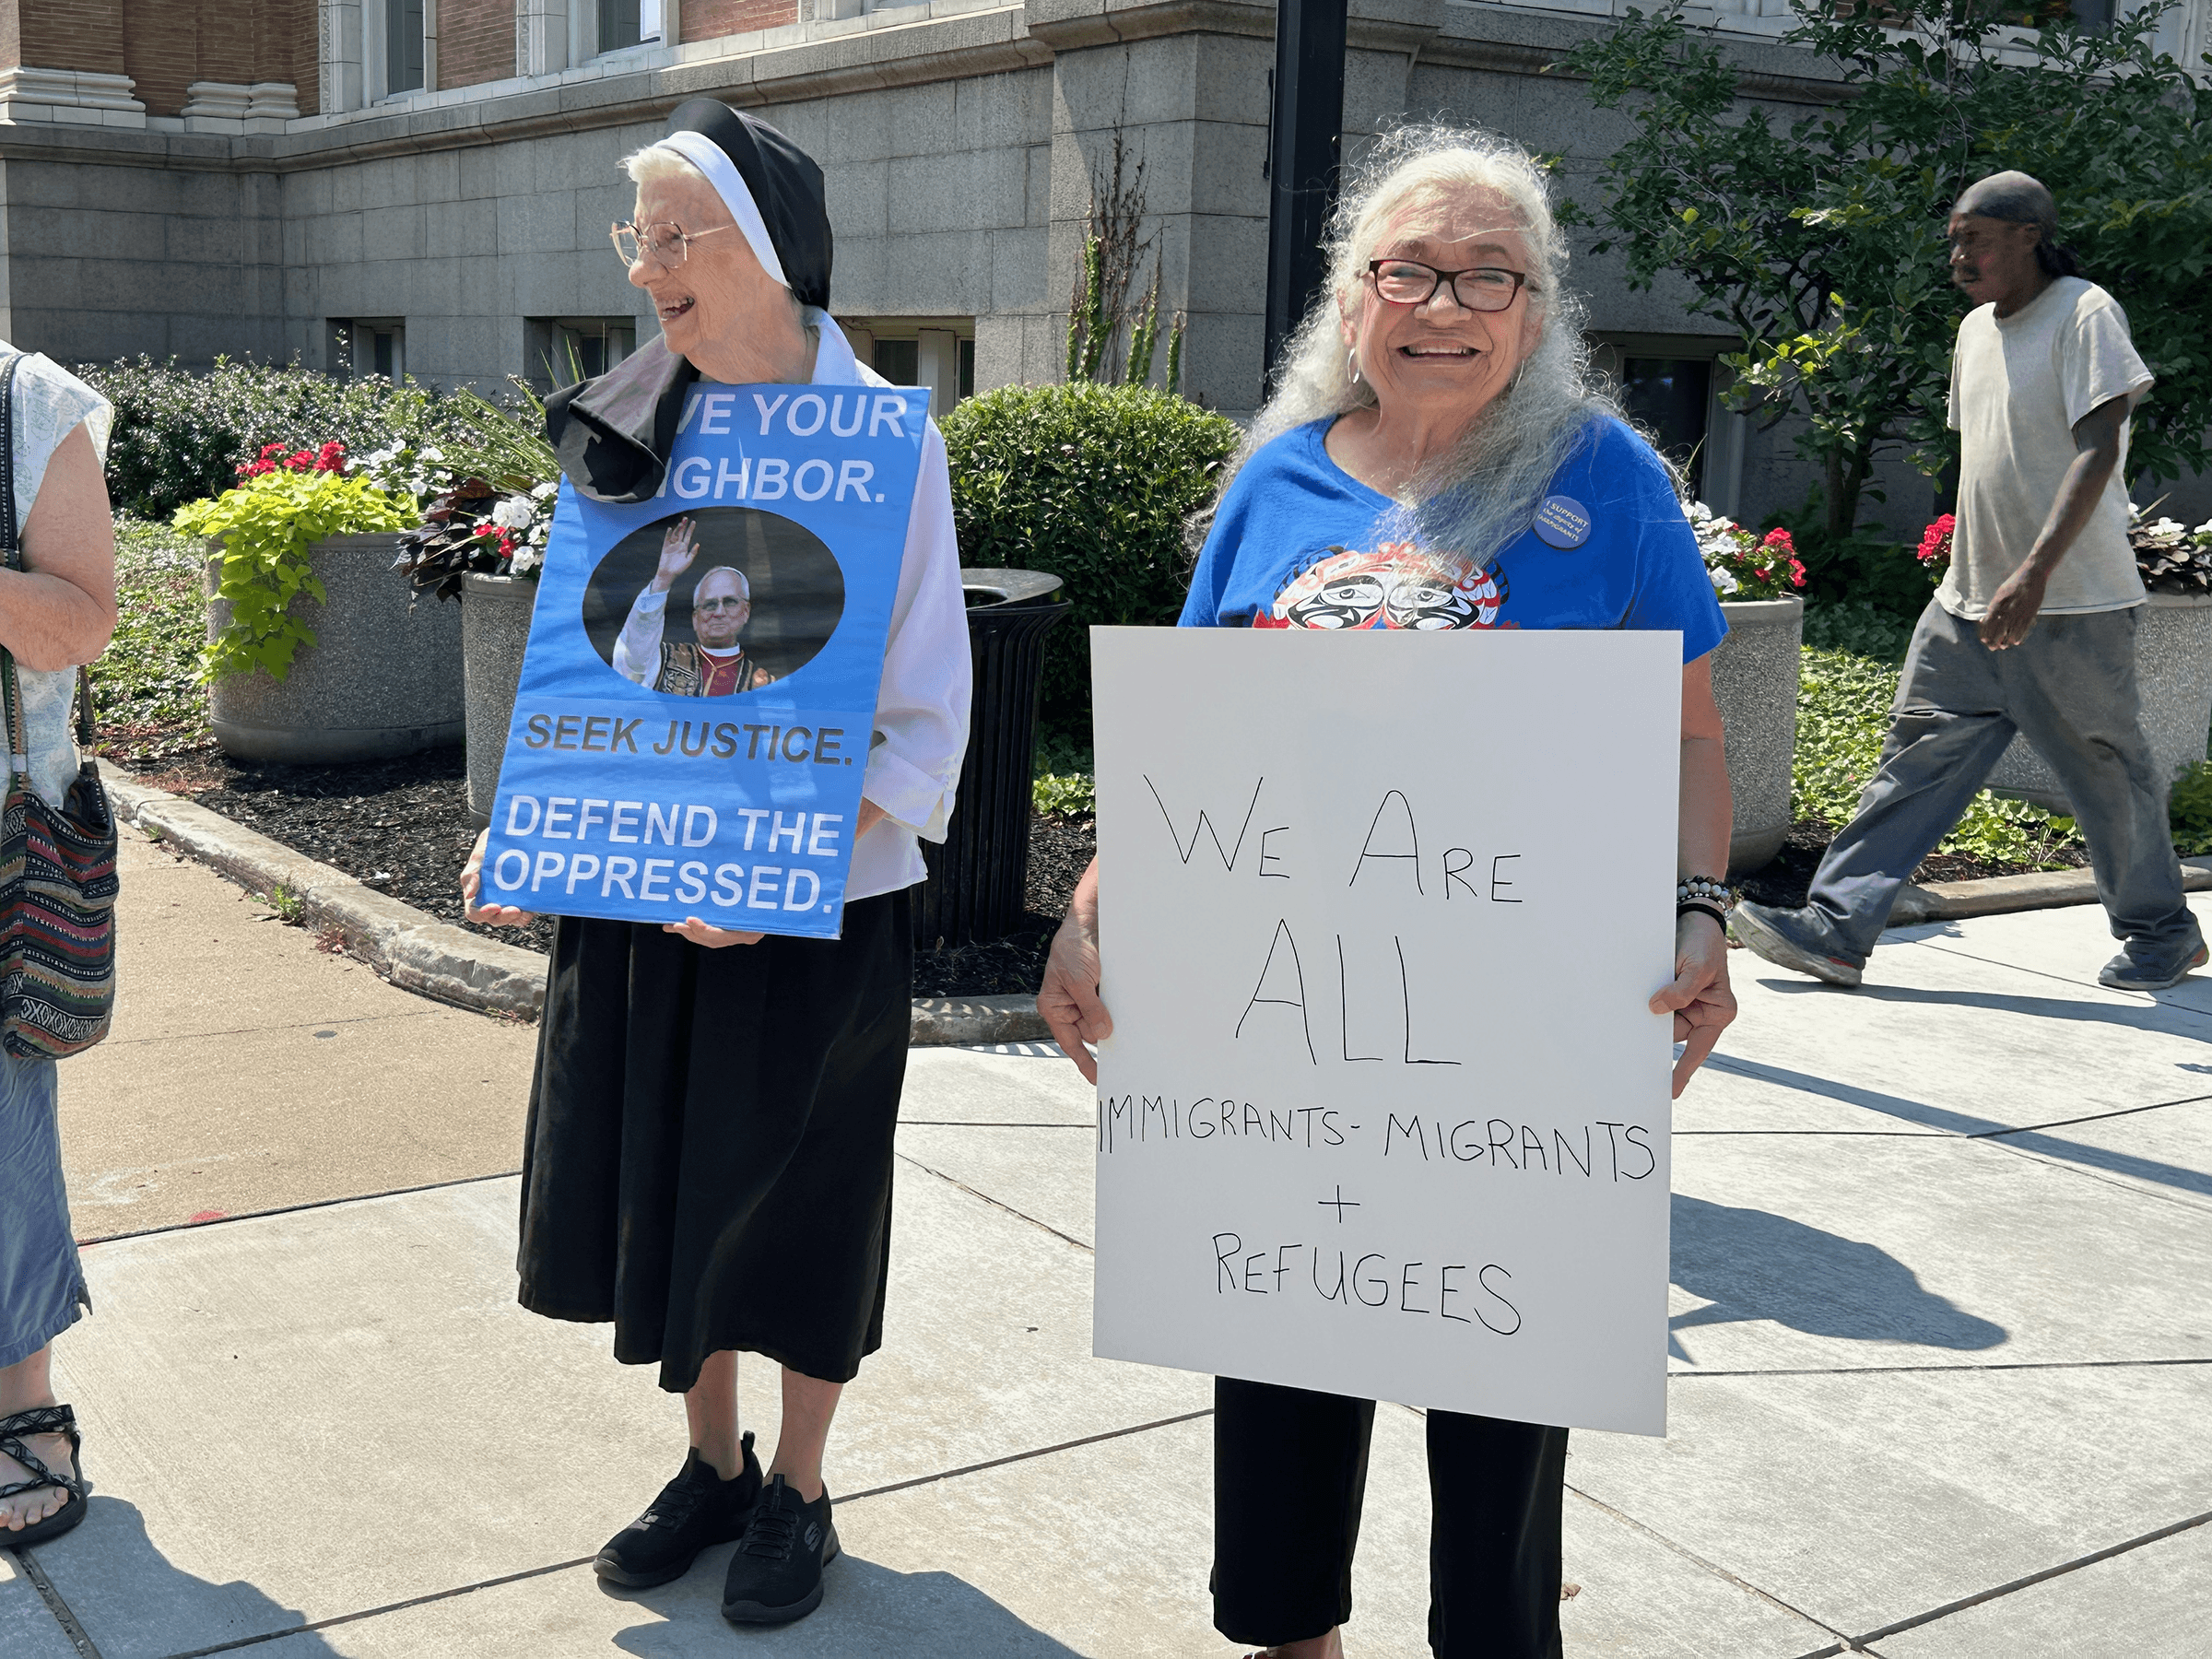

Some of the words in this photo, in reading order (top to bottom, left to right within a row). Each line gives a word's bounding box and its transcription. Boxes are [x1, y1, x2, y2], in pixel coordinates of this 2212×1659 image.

[676, 394, 736, 435] VE
[752, 394, 907, 438] YOUR
[655, 455, 885, 503] IGHBOR.
[1550, 502, 1589, 528] SUPPORT
[524, 713, 643, 754] SEEK
[653, 720, 853, 766] JUSTICE.
[505, 794, 718, 848] DEFEND
[737, 807, 843, 857] THE
[493, 849, 832, 913] OPPRESSED.
[1235, 918, 1463, 1066] ALL
[1383, 1112, 1655, 1182] MIGRANTS
[1212, 1232, 1522, 1335] REFUGEES
